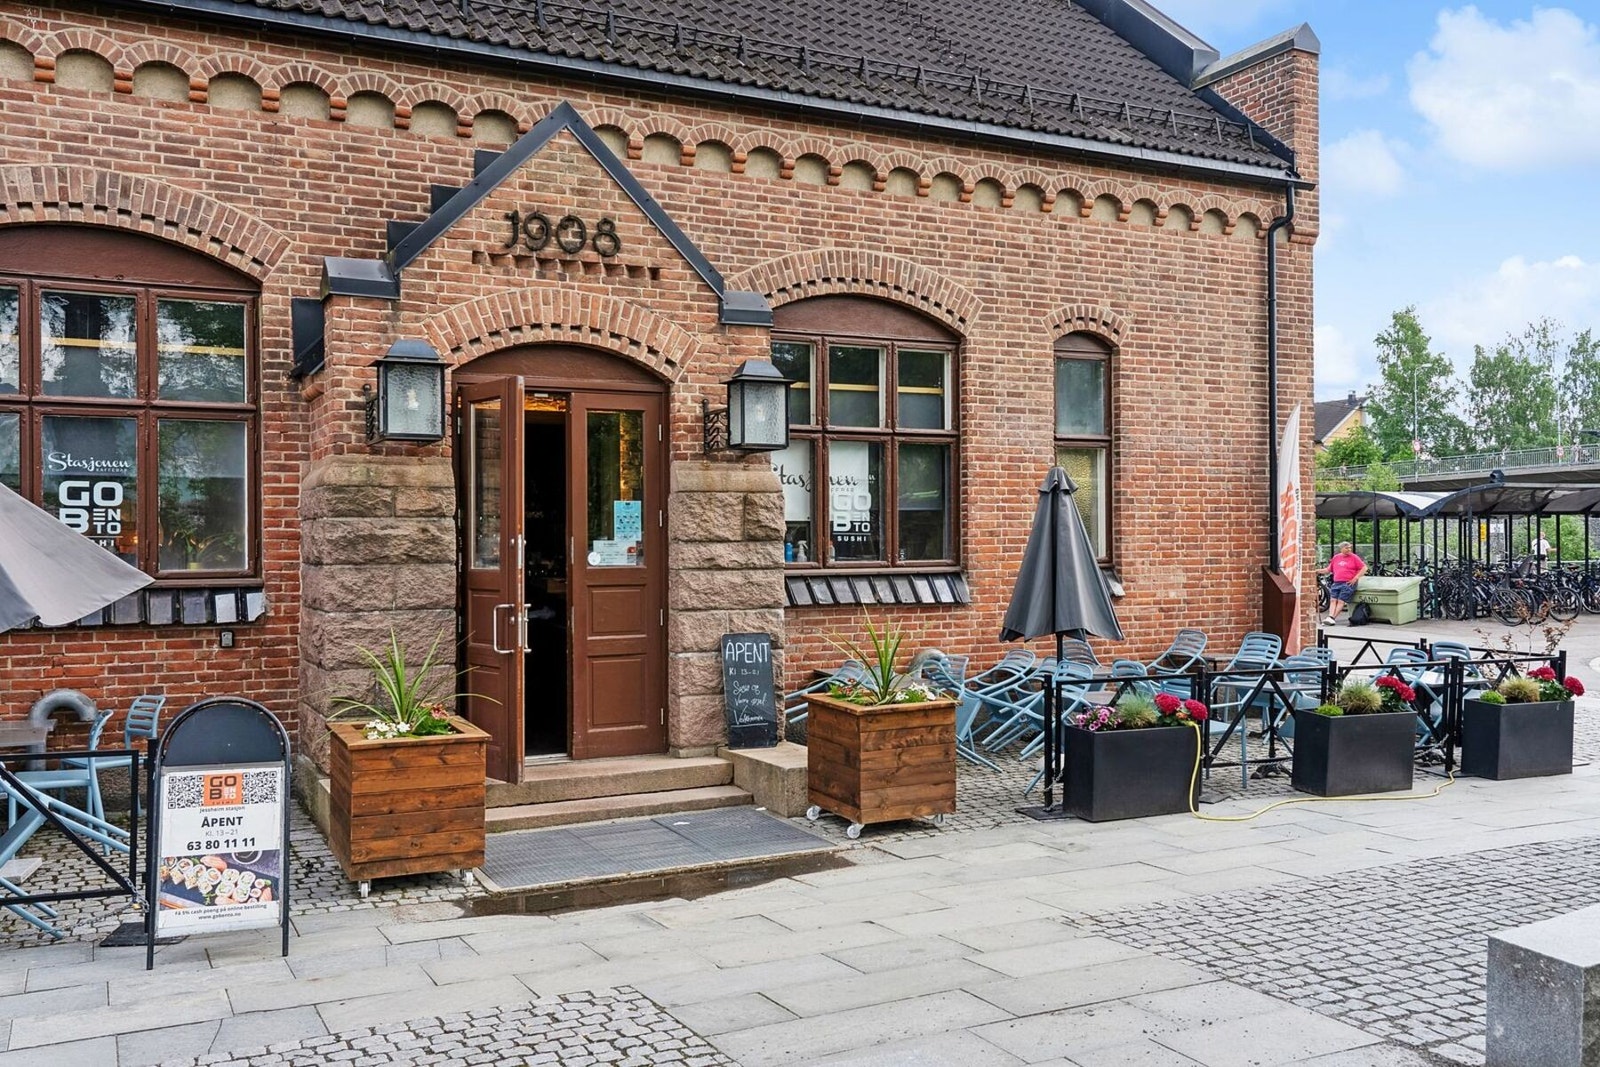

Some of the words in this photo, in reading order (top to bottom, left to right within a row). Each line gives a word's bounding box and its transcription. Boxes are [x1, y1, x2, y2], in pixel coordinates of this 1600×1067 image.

[504, 210, 621, 257] 1908
[48, 452, 131, 471] Stasjonen
[59, 480, 123, 506] GO
[833, 491, 871, 511] GO
[726, 640, 769, 663] ÅPENT
[210, 775, 237, 787] GO
[201, 816, 244, 828] ÅPENT
[187, 841, 202, 851] 63
[205, 840, 220, 850] 80
[224, 838, 237, 848] 11
[242, 837, 255, 847] 11
